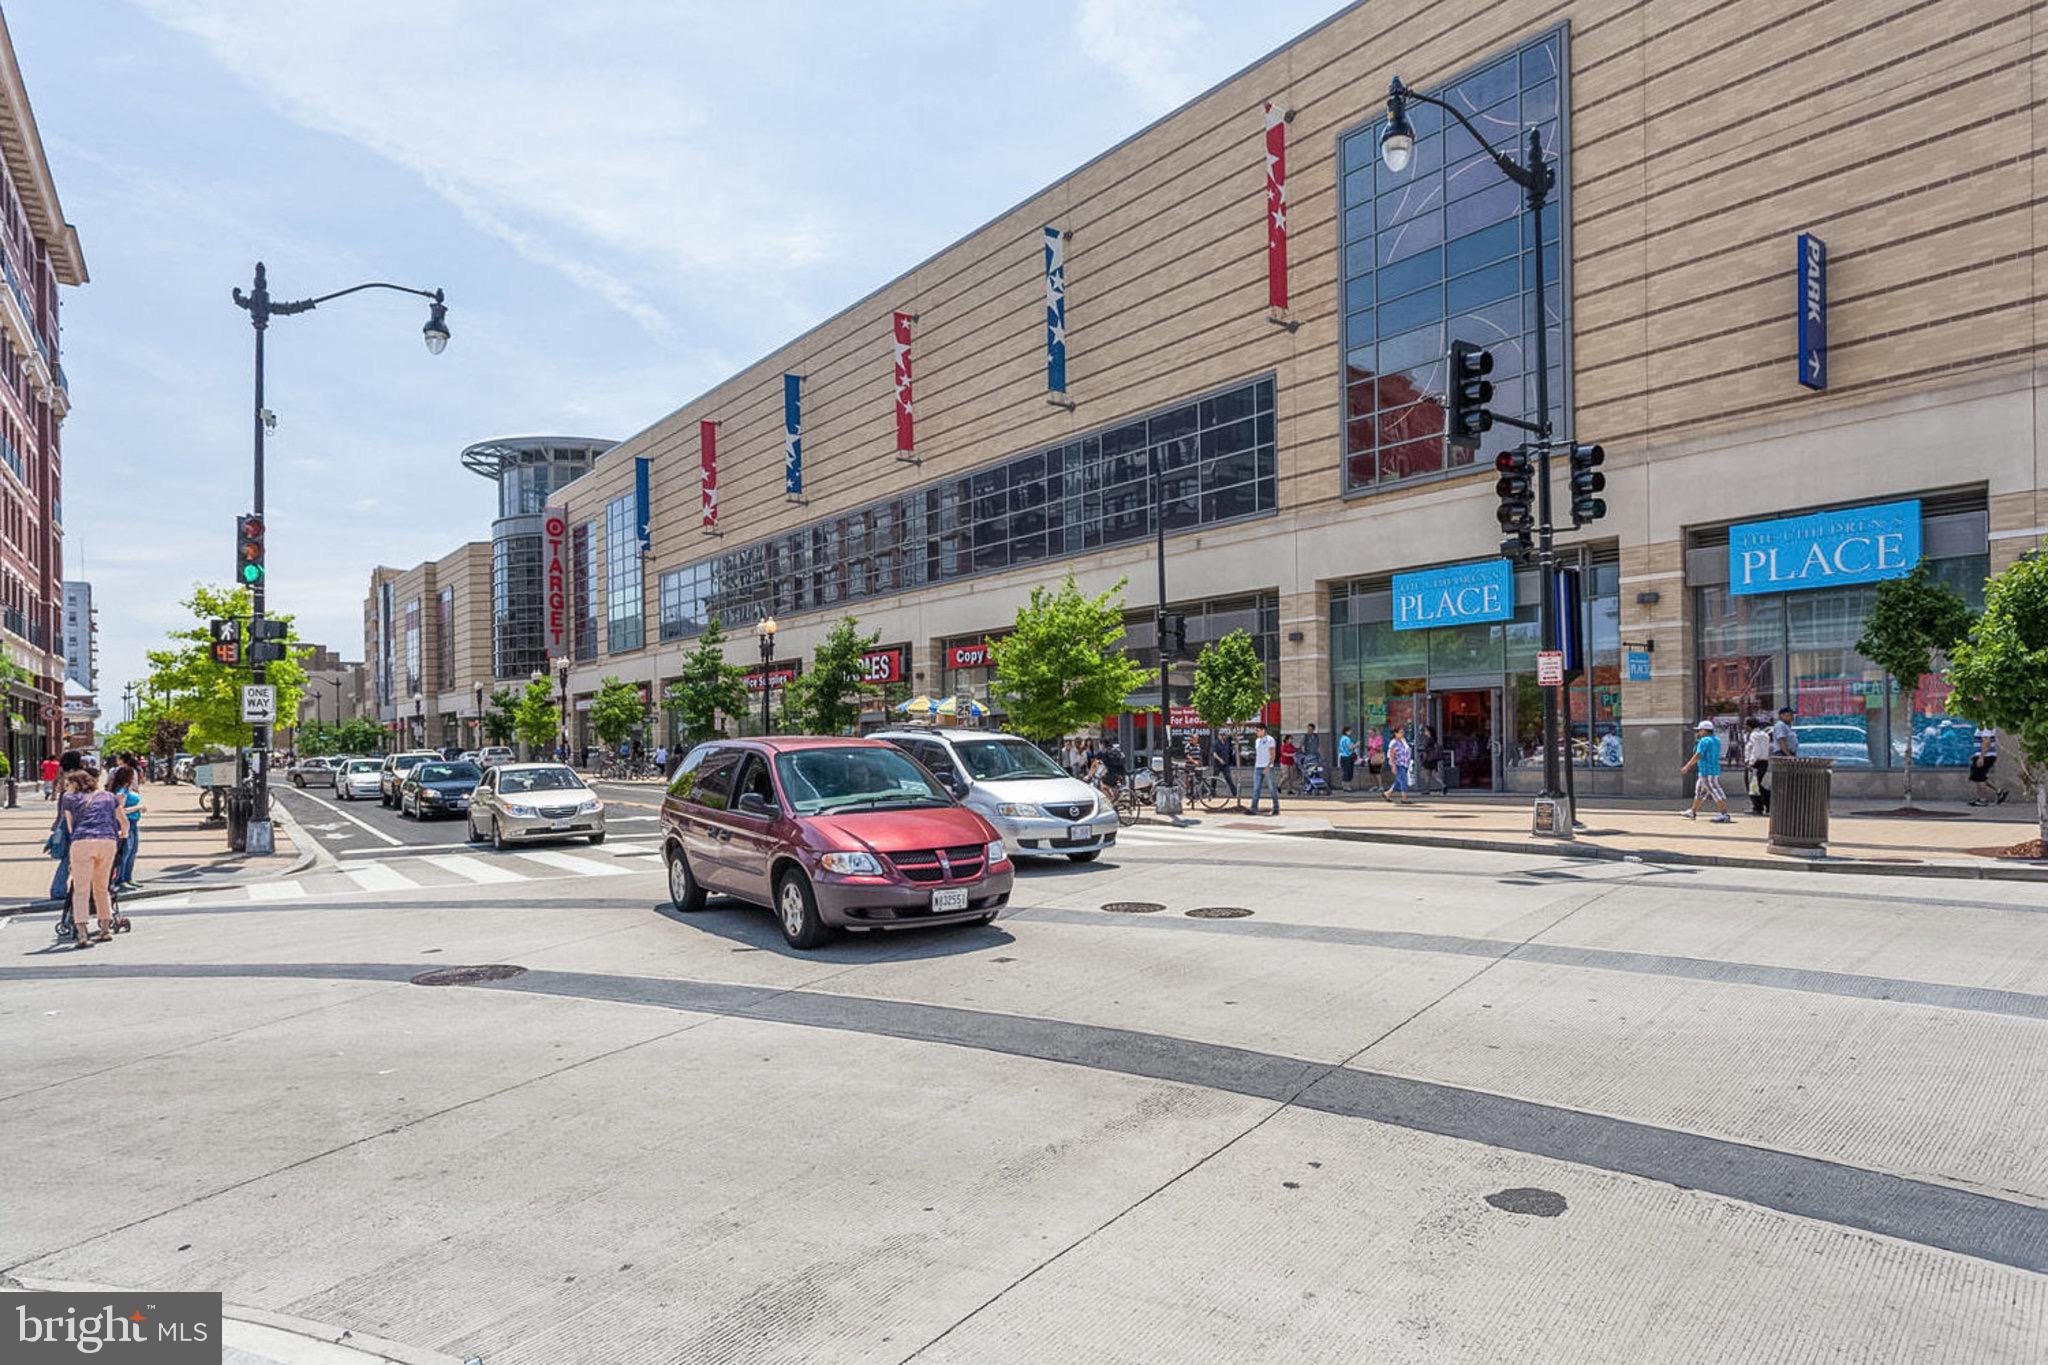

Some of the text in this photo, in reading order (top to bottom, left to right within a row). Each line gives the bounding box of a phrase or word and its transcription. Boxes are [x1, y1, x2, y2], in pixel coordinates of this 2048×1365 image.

[1807, 237, 1821, 323] PARK
[1741, 533, 1906, 584] PLACE
[548, 538, 564, 646] TARGET
[1400, 584, 1501, 621] PLACE
[216, 643, 237, 662] 43
[956, 650, 984, 664] Copy
[248, 688, 269, 698] ONE
[247, 698, 270, 708] WAY
[1171, 715, 1183, 725] For
